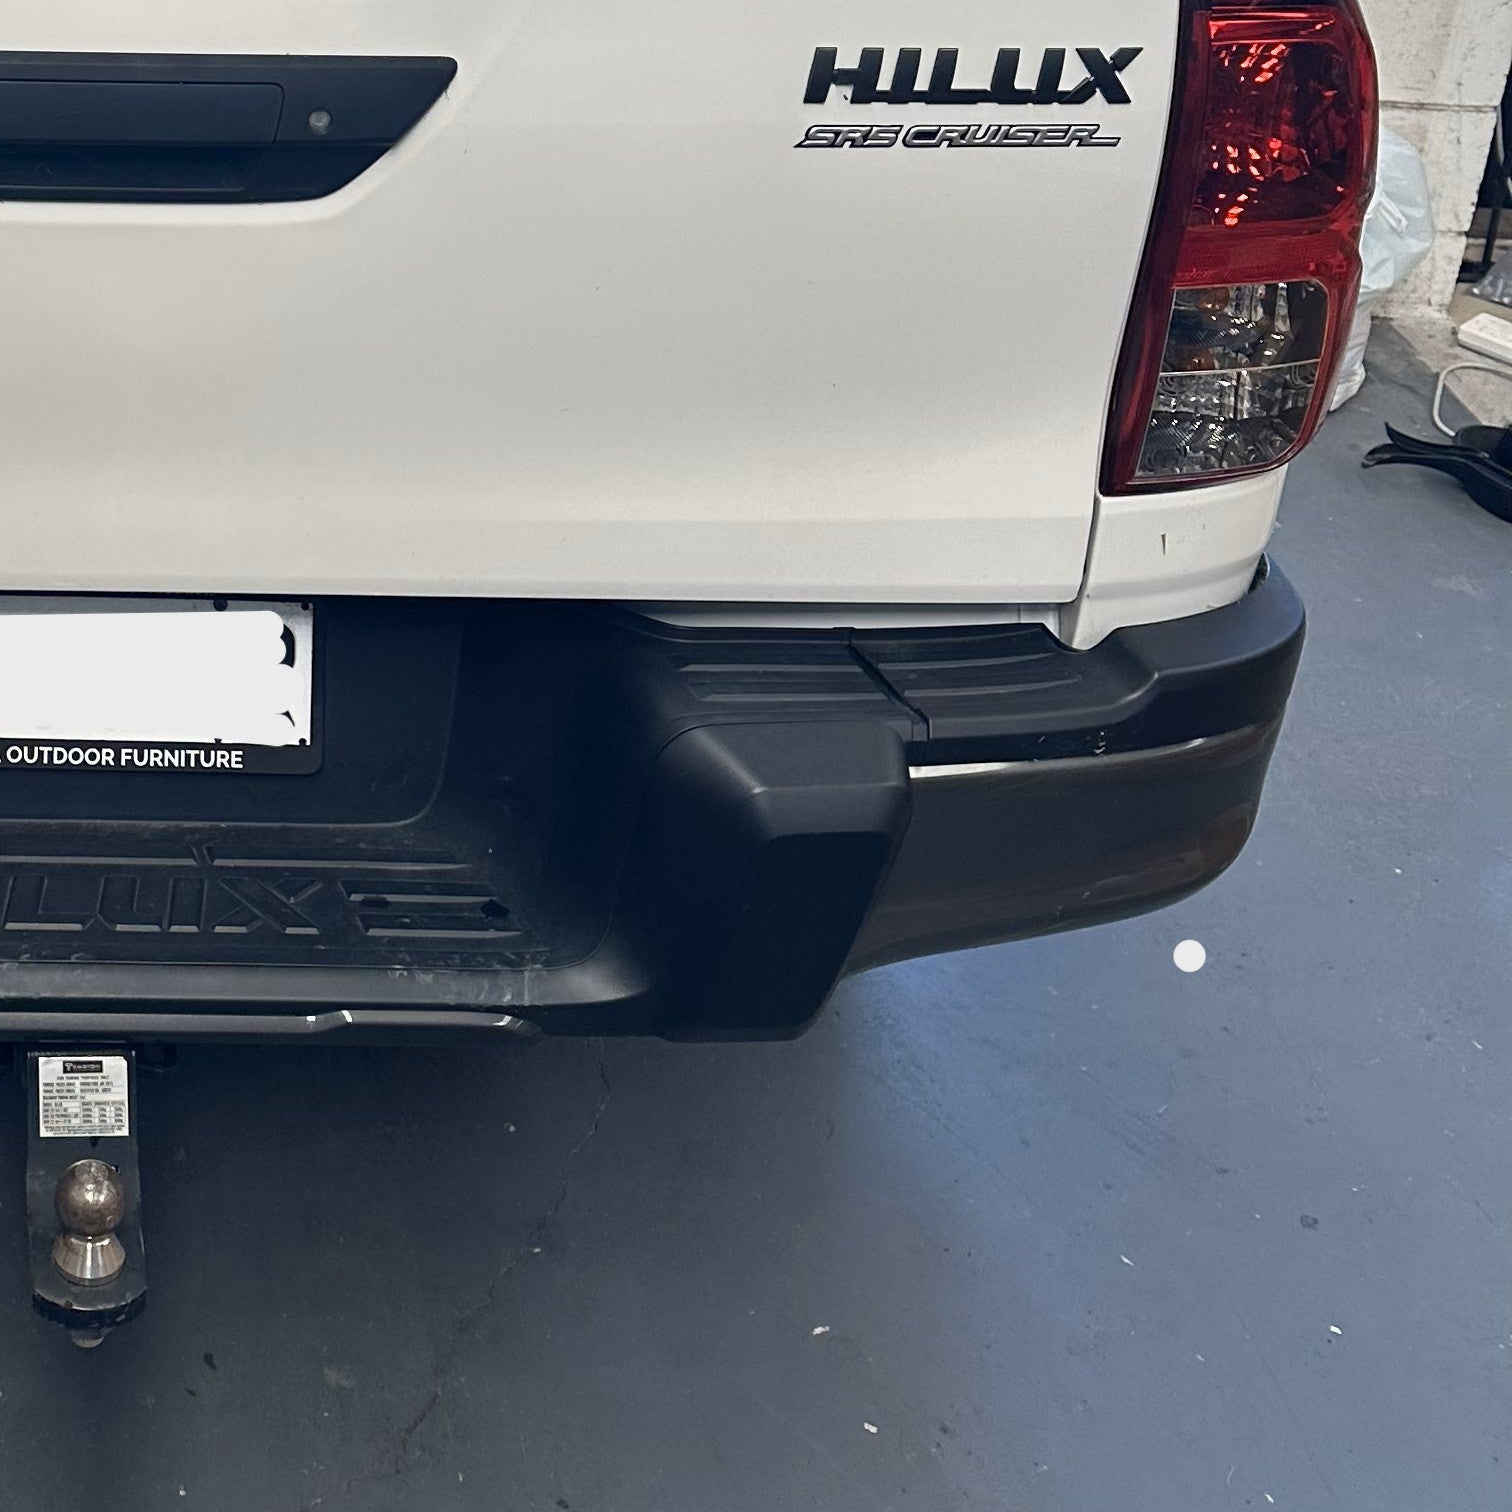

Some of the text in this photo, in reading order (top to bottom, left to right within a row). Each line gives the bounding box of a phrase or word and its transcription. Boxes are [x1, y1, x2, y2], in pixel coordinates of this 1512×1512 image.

[803, 46, 1143, 104] HILUX
[793, 124, 1122, 147] SR5 CRUISER
[6, 746, 115, 767] OUTDOOR
[121, 748, 244, 770] FURNITURE
